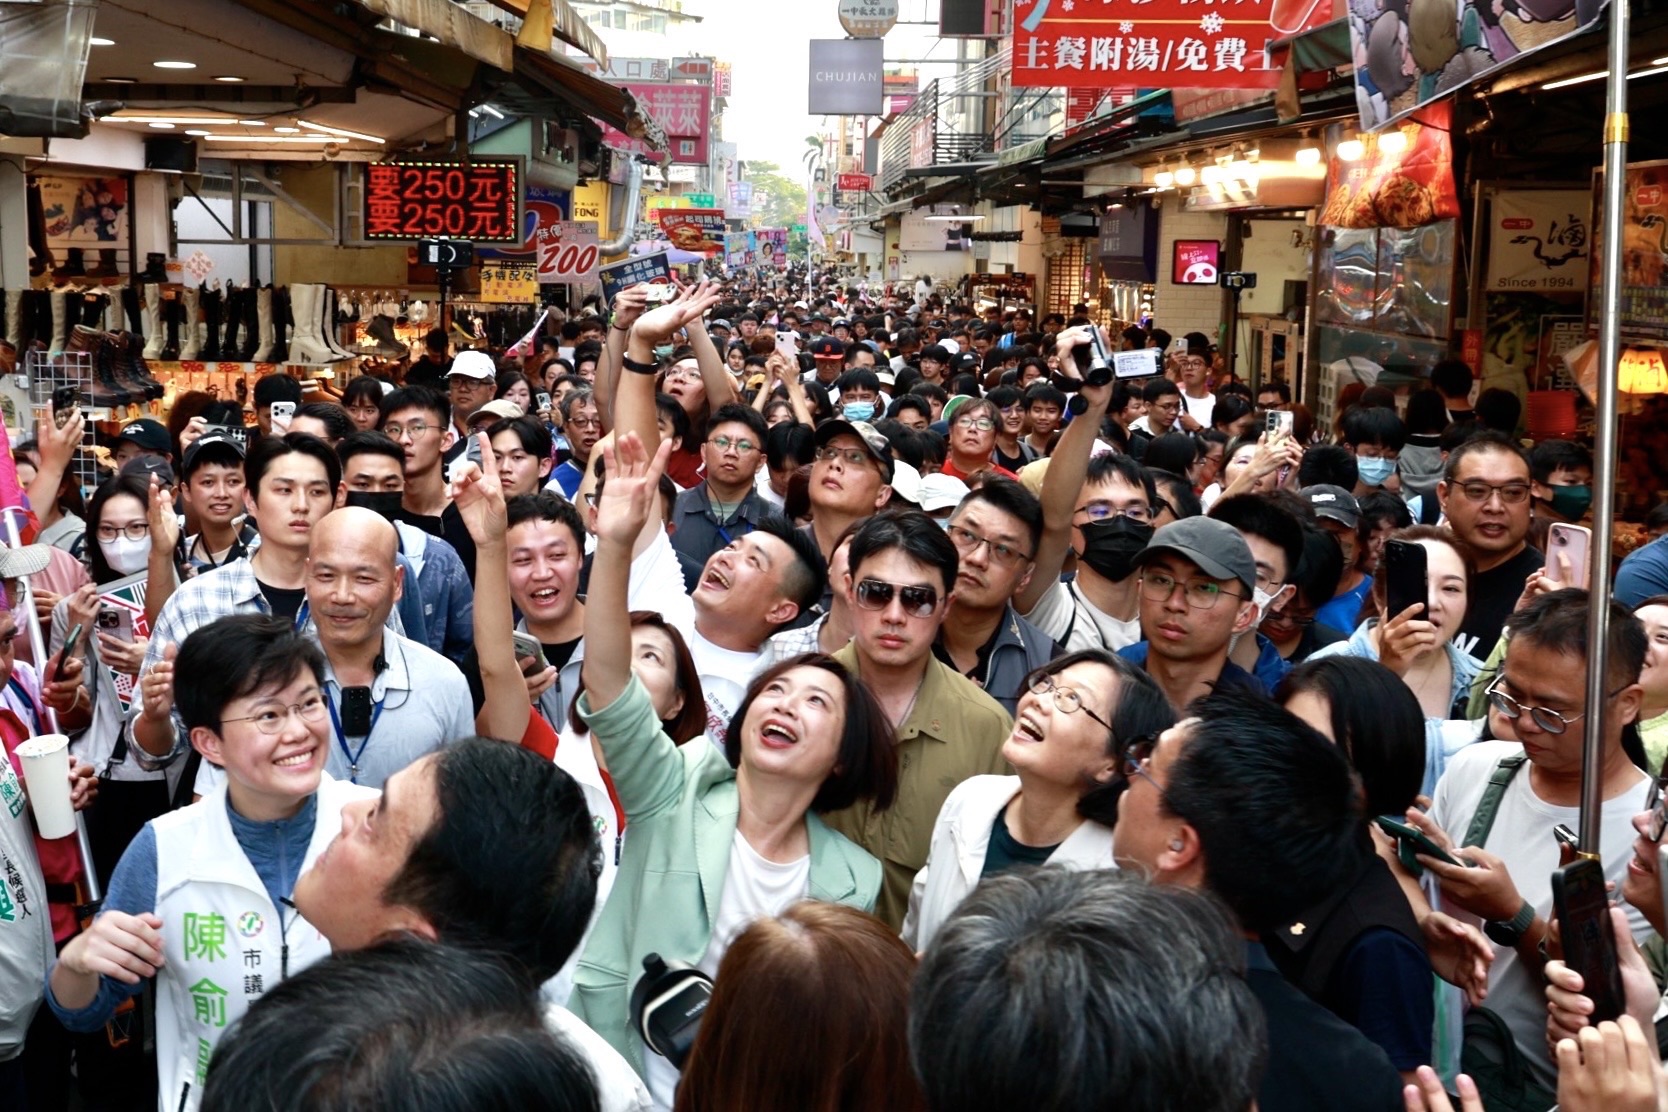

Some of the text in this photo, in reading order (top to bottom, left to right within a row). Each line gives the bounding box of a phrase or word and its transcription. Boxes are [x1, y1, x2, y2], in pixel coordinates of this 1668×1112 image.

[816, 71, 877, 81] CHUJIAN
[1637, 189, 1660, 203] 一中
[574, 207, 599, 217] FONG
[1503, 220, 1531, 229] 一中
[537, 244, 598, 275] 200
[1497, 277, 1574, 288] Since 1994
[243, 948, 264, 1006] 市議
